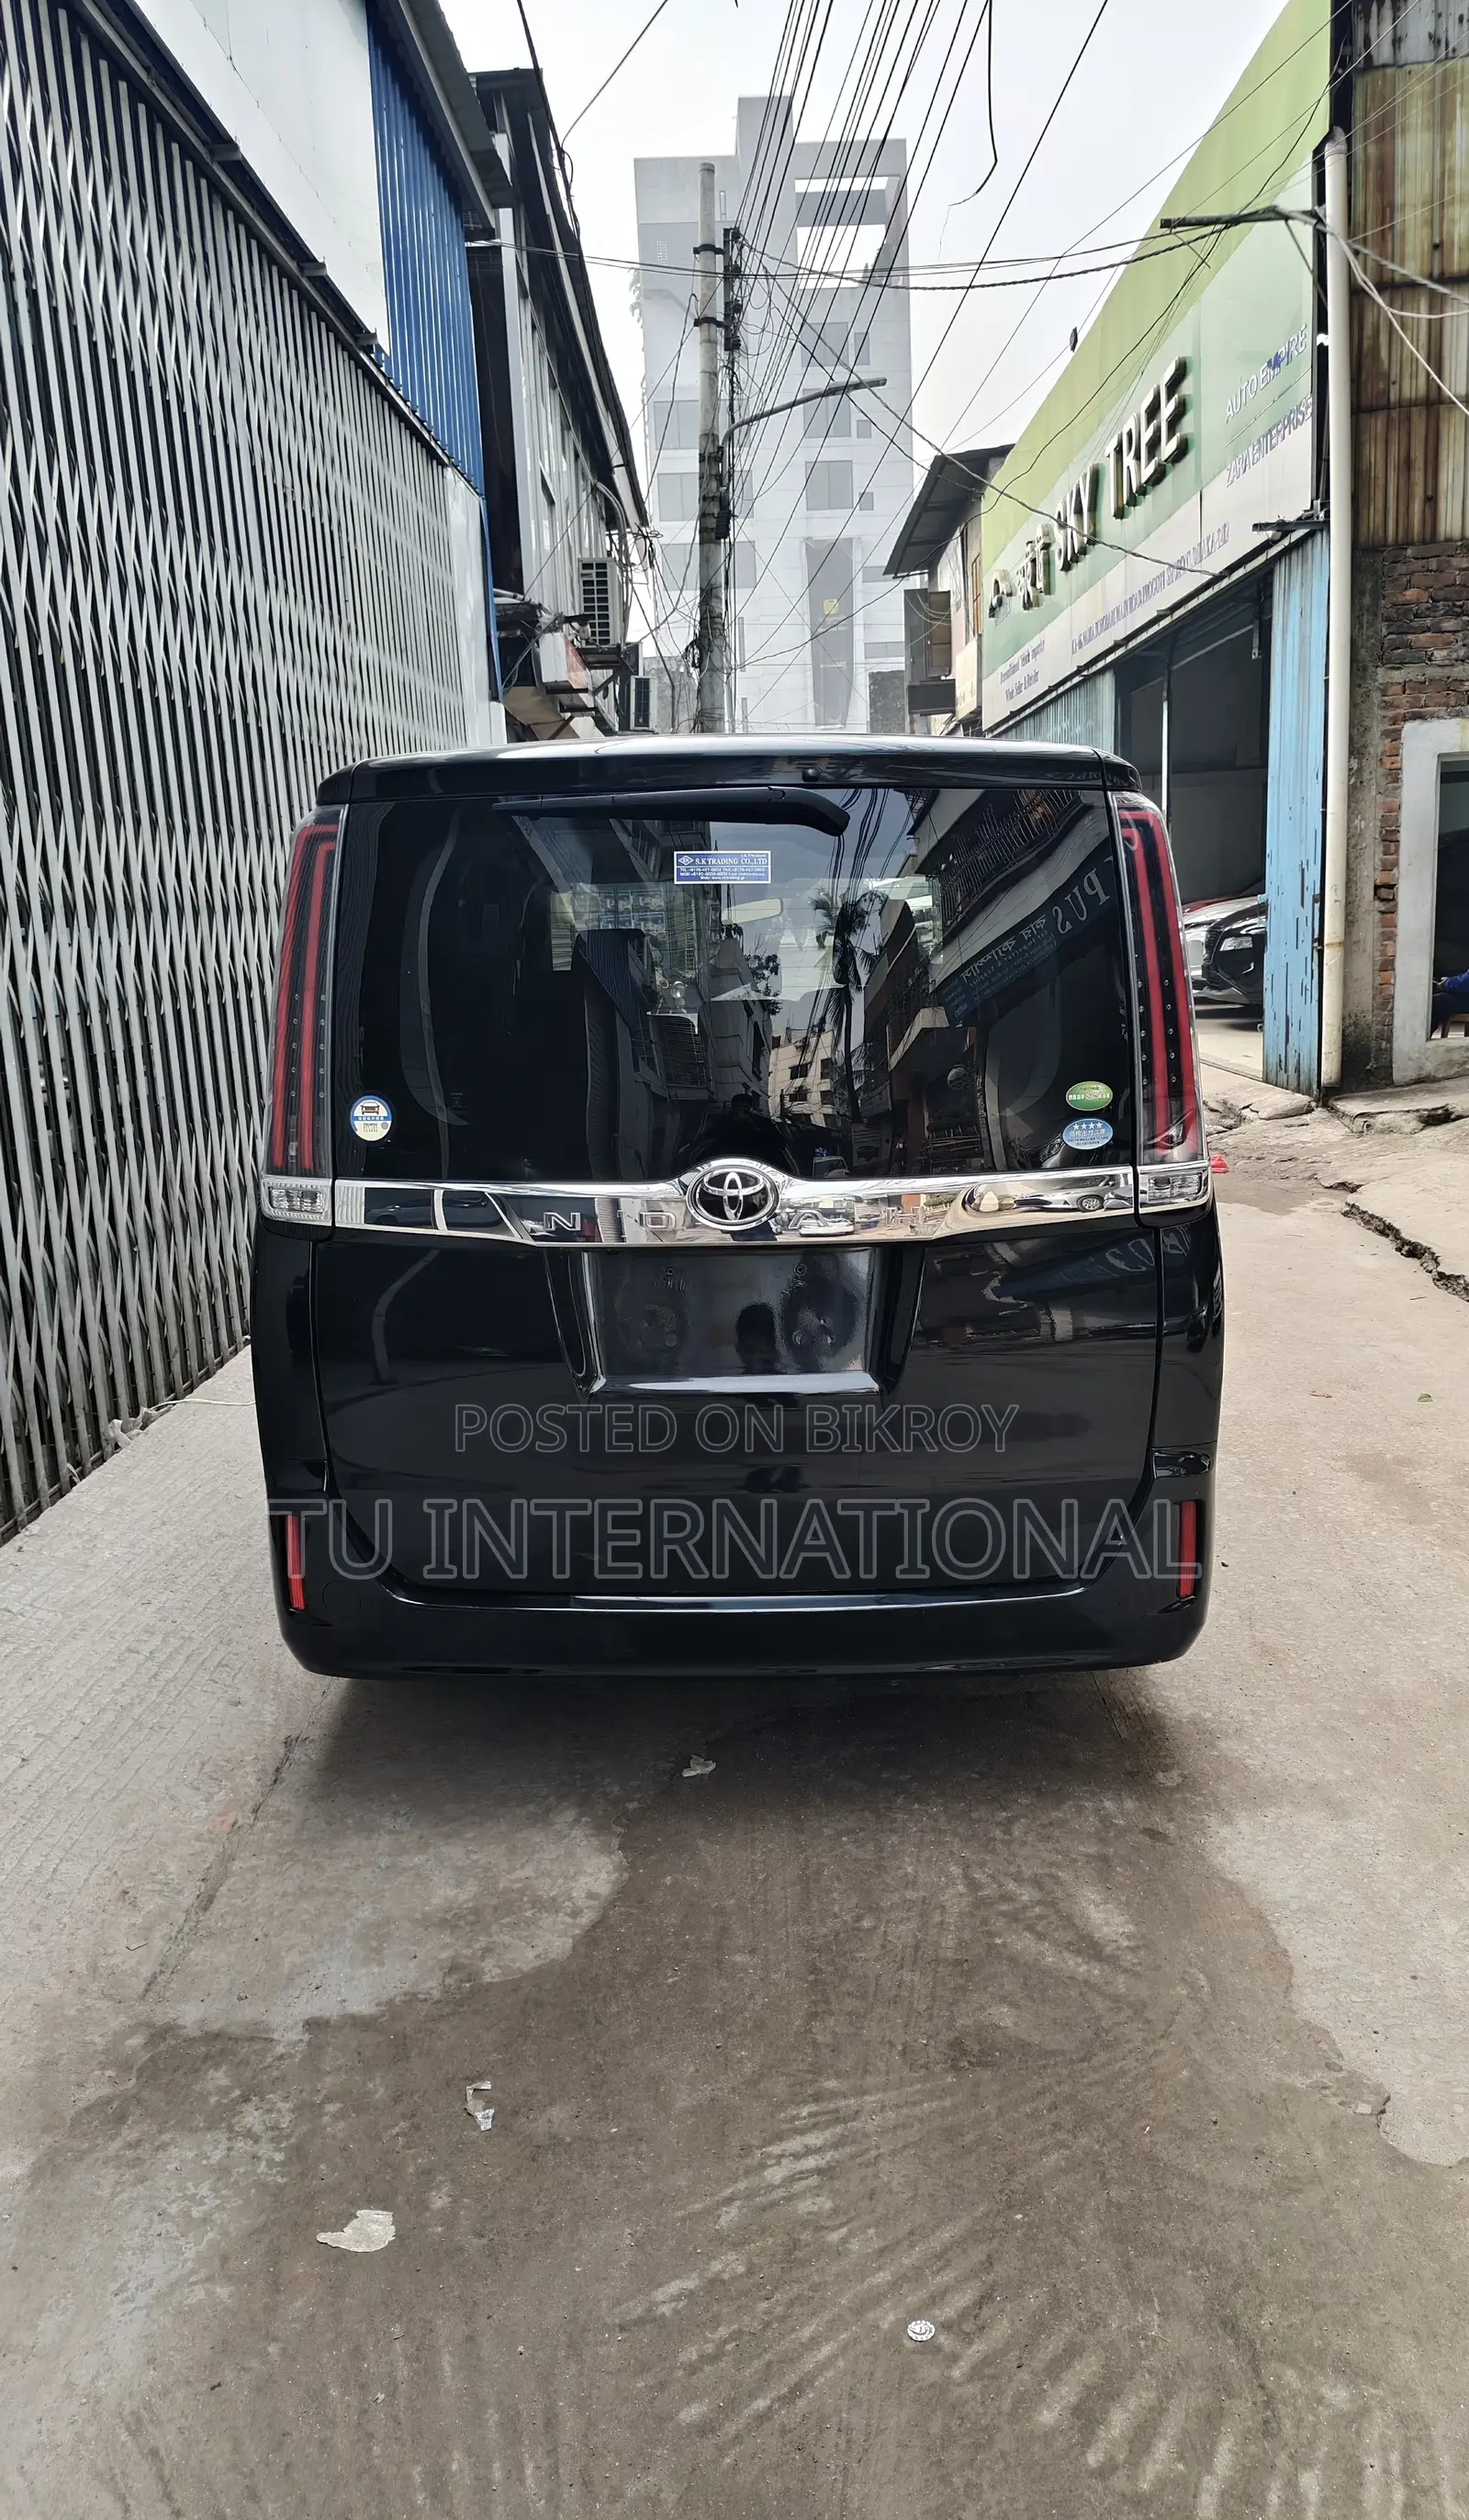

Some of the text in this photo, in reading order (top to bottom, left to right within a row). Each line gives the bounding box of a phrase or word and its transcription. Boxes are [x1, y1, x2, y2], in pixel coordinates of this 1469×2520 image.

[1226, 323, 1307, 424] AUTO EMPIRE
[1054, 355, 1188, 572] SKY TREE
[1226, 393, 1313, 488] ZARA ENTERPRISE
[707, 857, 738, 866] TRADING
